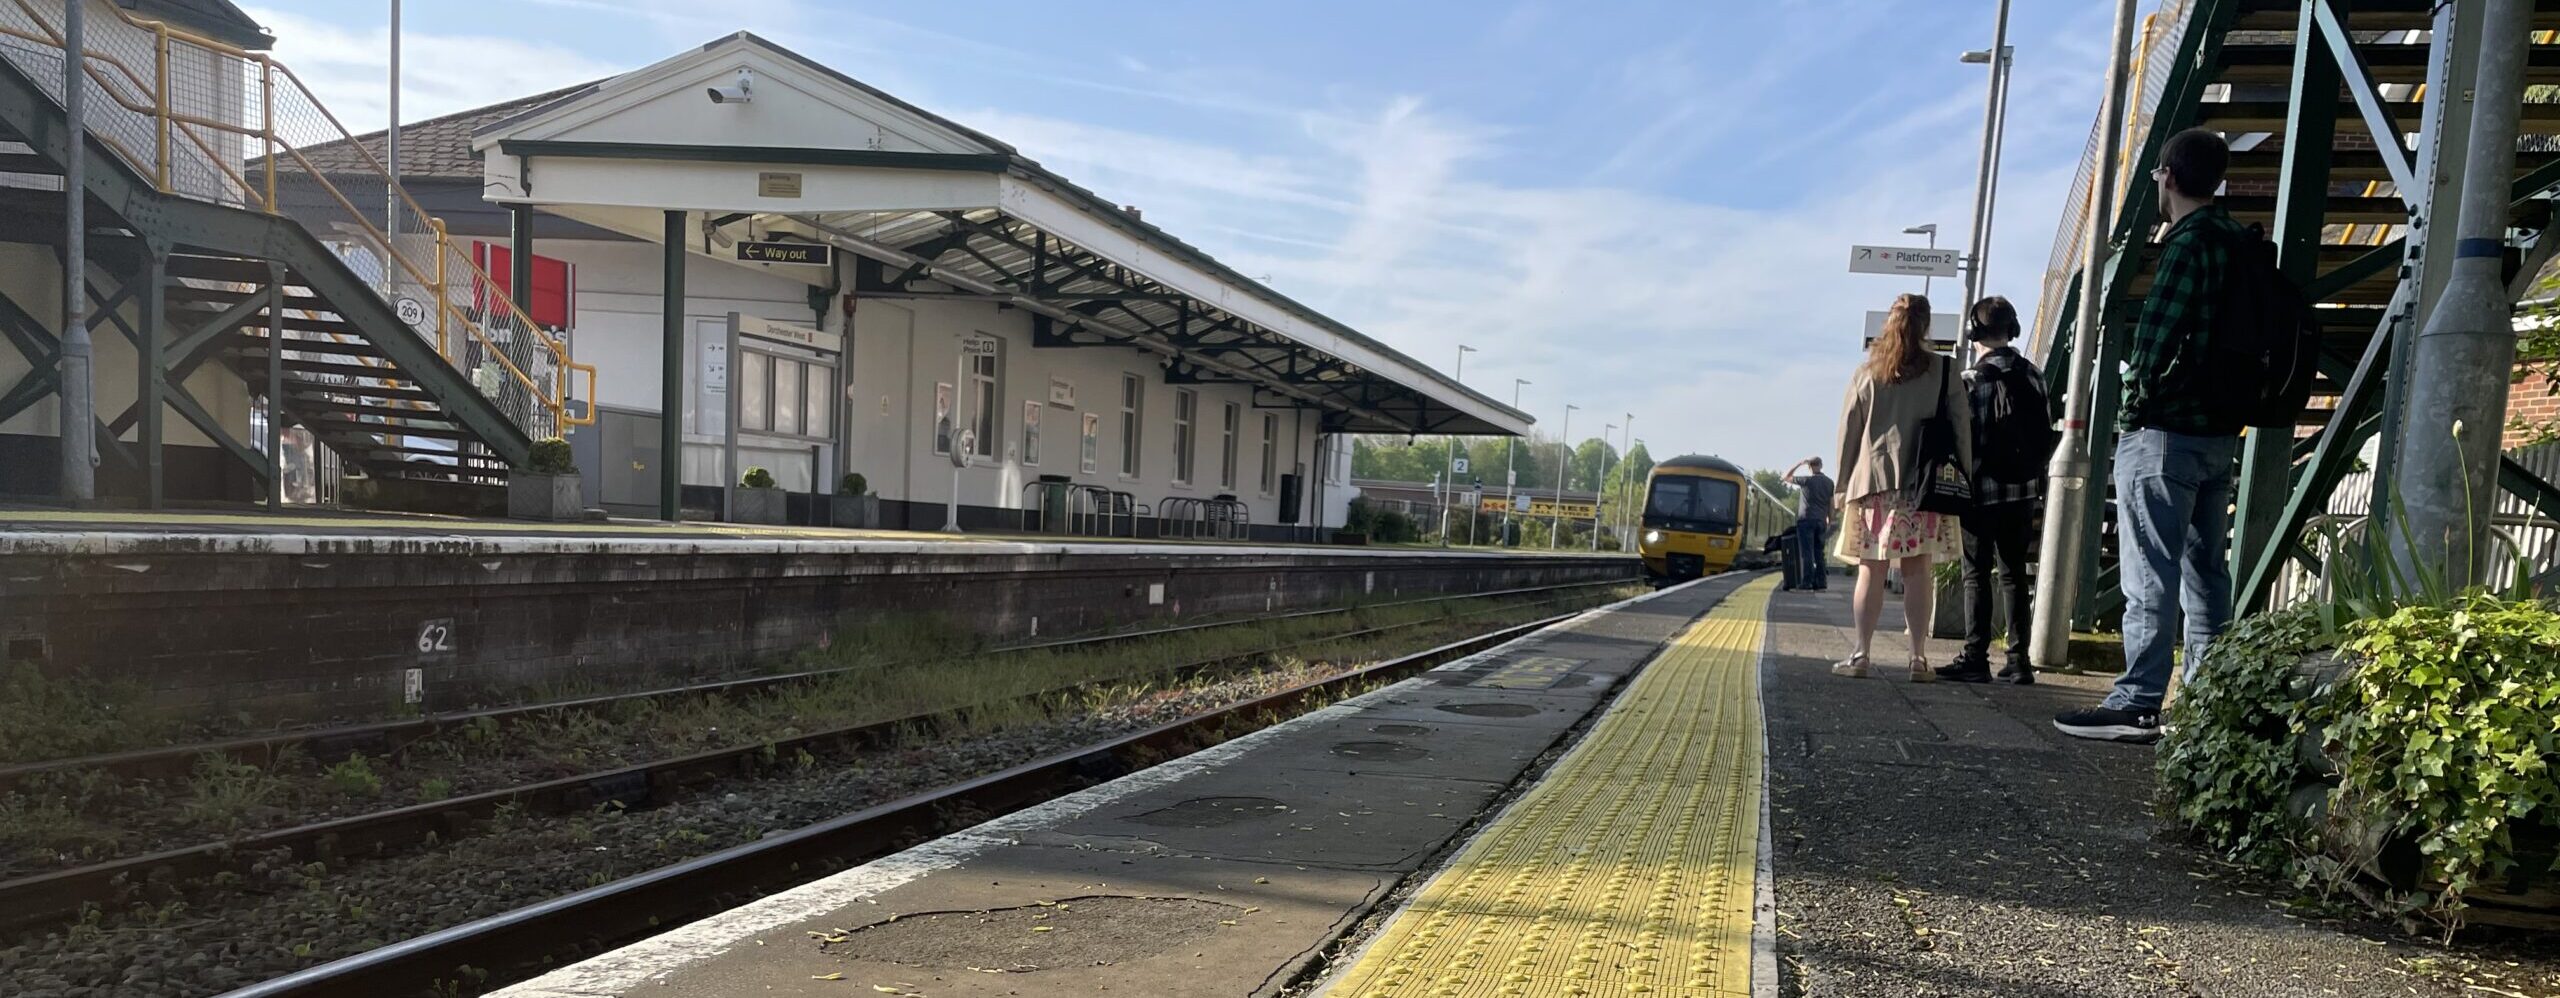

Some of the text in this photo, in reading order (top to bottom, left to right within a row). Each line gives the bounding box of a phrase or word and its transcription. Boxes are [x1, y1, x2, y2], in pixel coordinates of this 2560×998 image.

[764, 247, 807, 261] Way out
[1896, 251, 1952, 264] Platform 2
[402, 305, 418, 319] 209
[1456, 460, 1465, 471] 2
[419, 624, 448, 653] 62
